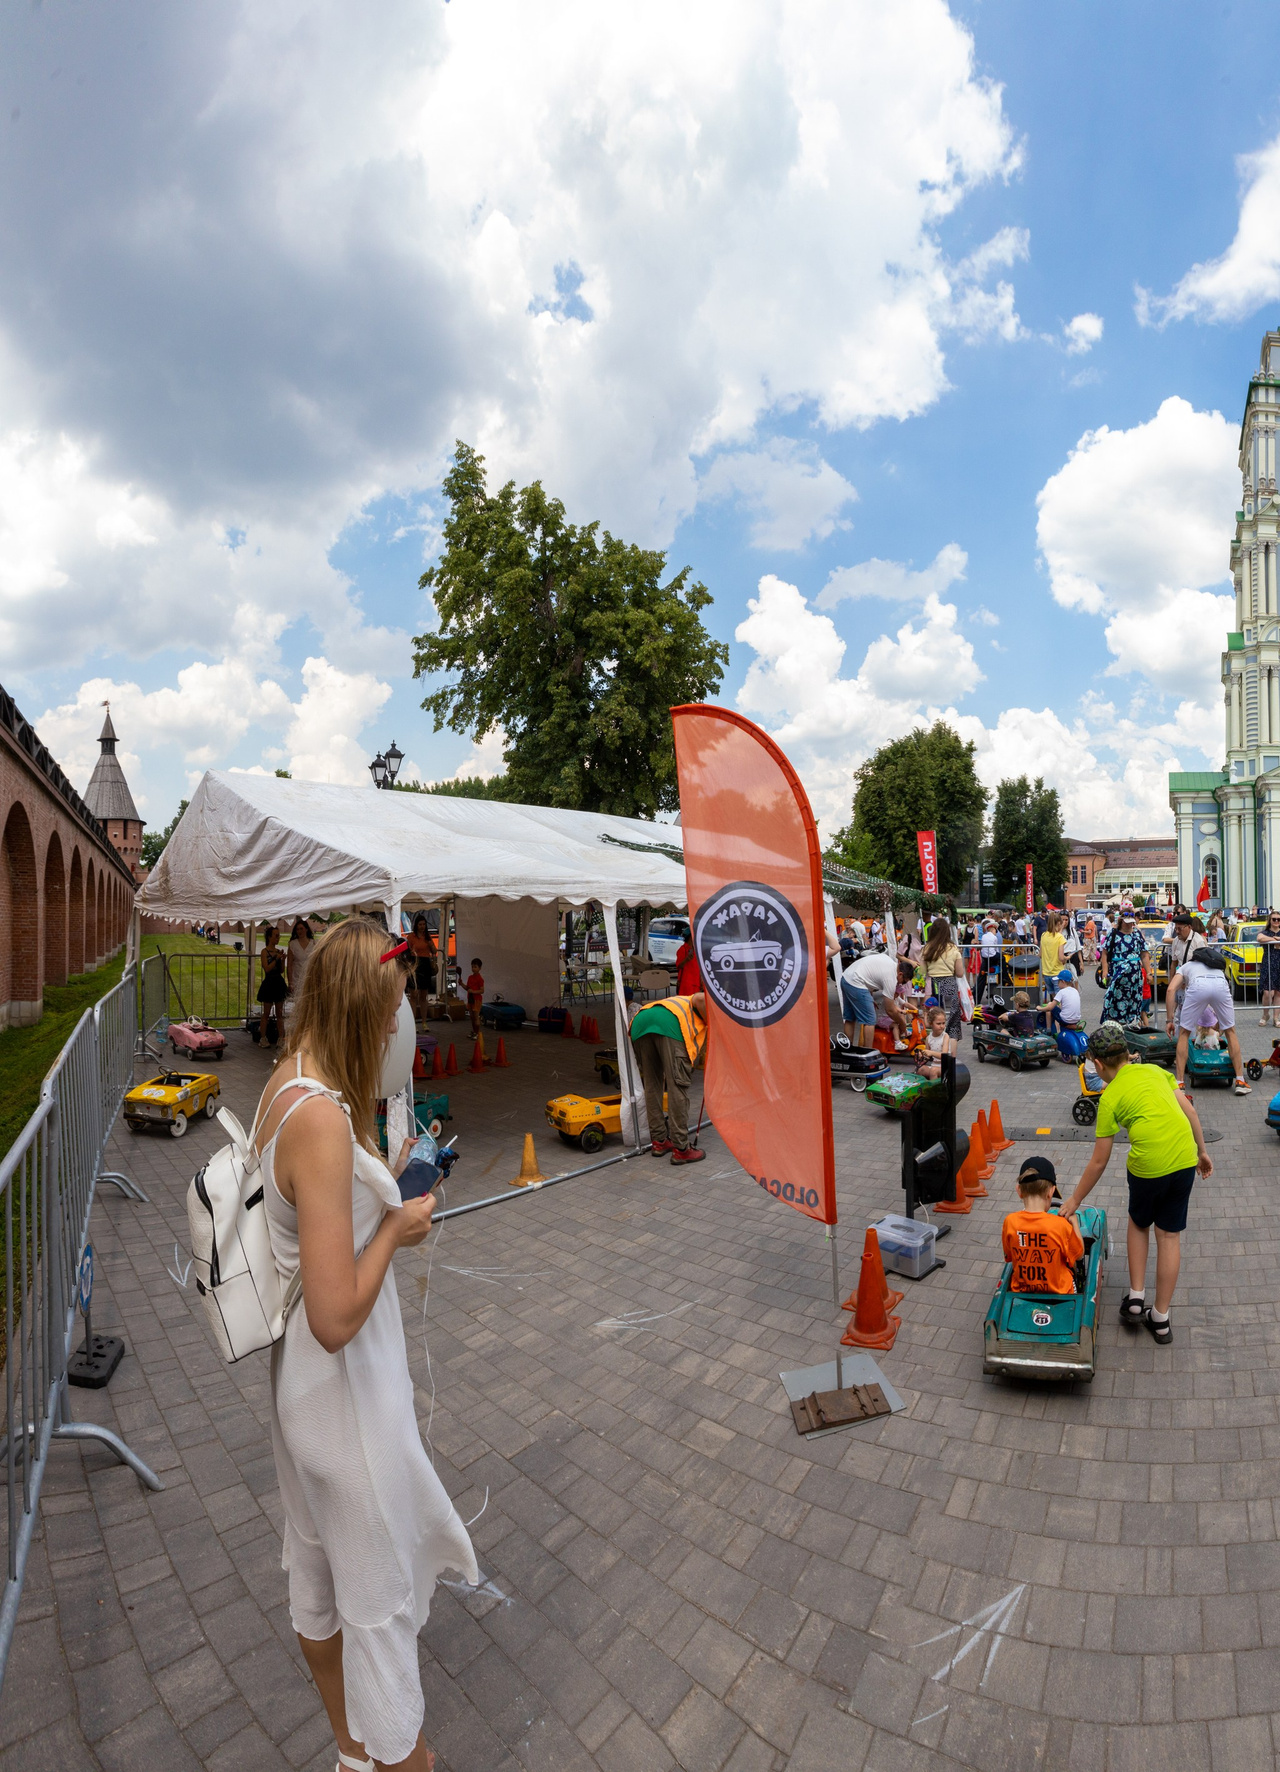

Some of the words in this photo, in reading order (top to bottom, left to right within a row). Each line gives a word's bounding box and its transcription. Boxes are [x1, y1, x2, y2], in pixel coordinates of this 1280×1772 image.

[923, 841, 936, 895] uto.ru
[1017, 1230, 1048, 1247] THE
[1012, 1247, 1056, 1263] WAY
[1018, 1265, 1047, 1281] FOR
